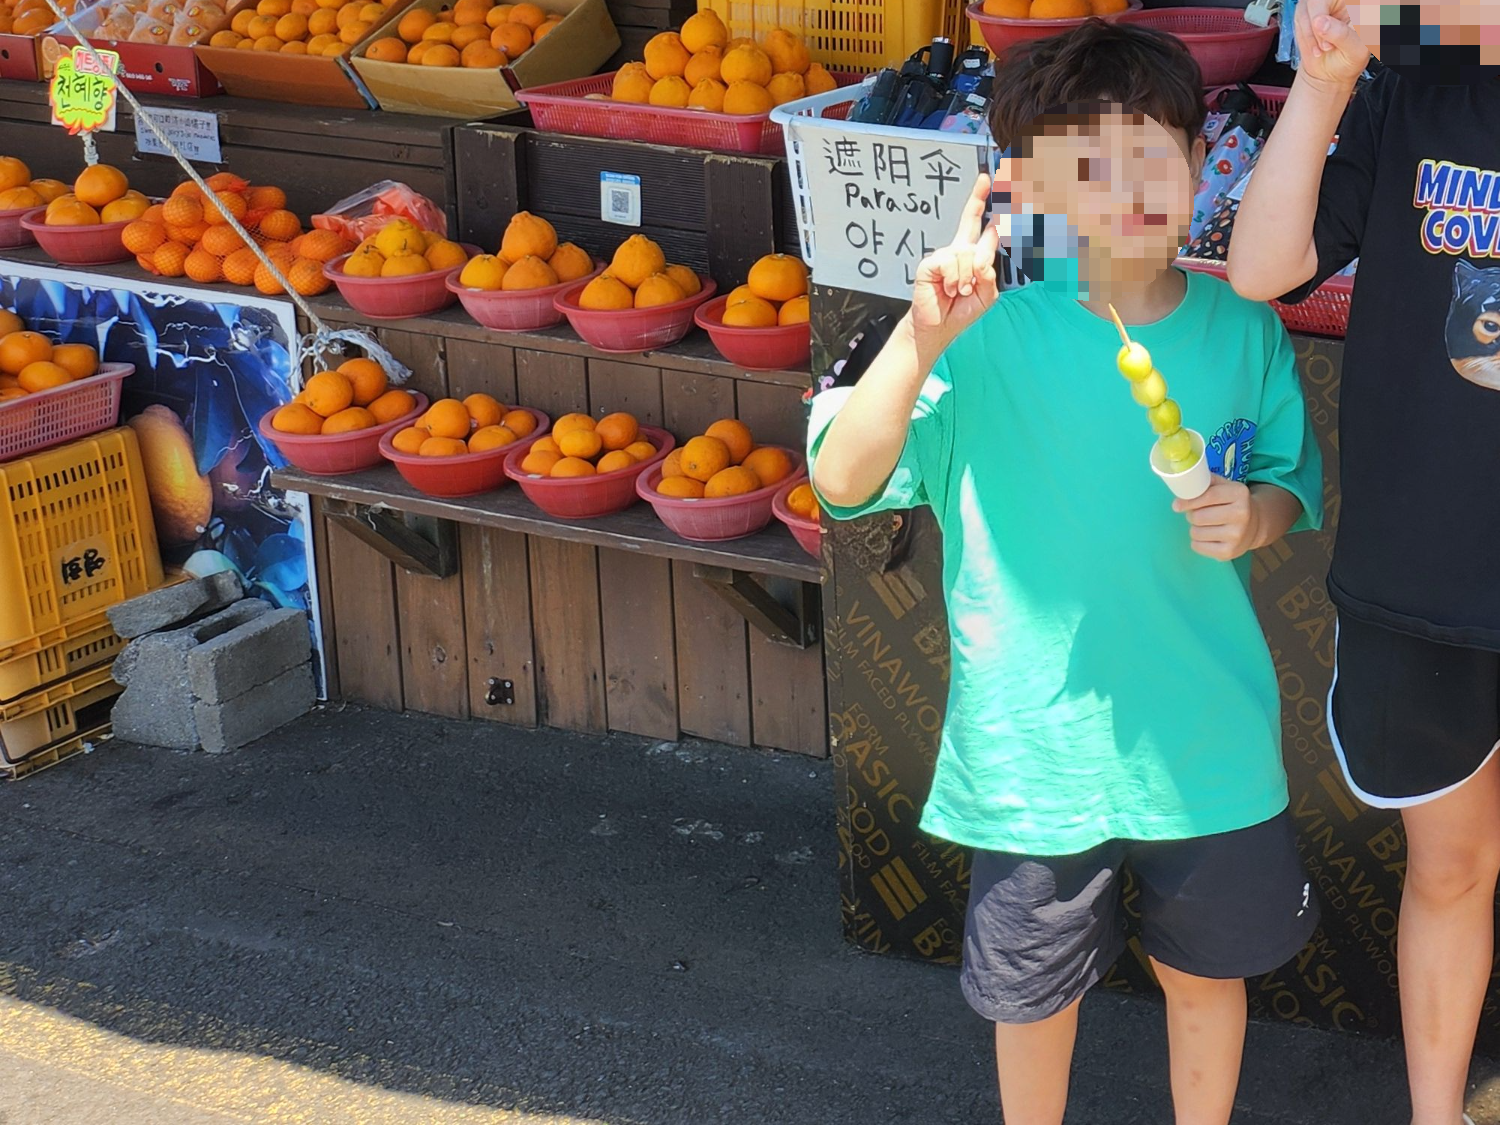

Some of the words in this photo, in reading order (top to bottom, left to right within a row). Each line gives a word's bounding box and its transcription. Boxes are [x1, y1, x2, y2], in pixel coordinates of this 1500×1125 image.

[58, 73, 108, 111] 천혜향
[823, 136, 961, 196] 遮阳伞
[845, 218, 937, 286] 양산
[846, 600, 941, 748] VINAWO
[857, 659, 897, 711] FACED
[848, 701, 889, 756] FORM
[1304, 854, 1347, 911] FACED
[1344, 912, 1398, 989] PLYWOO
